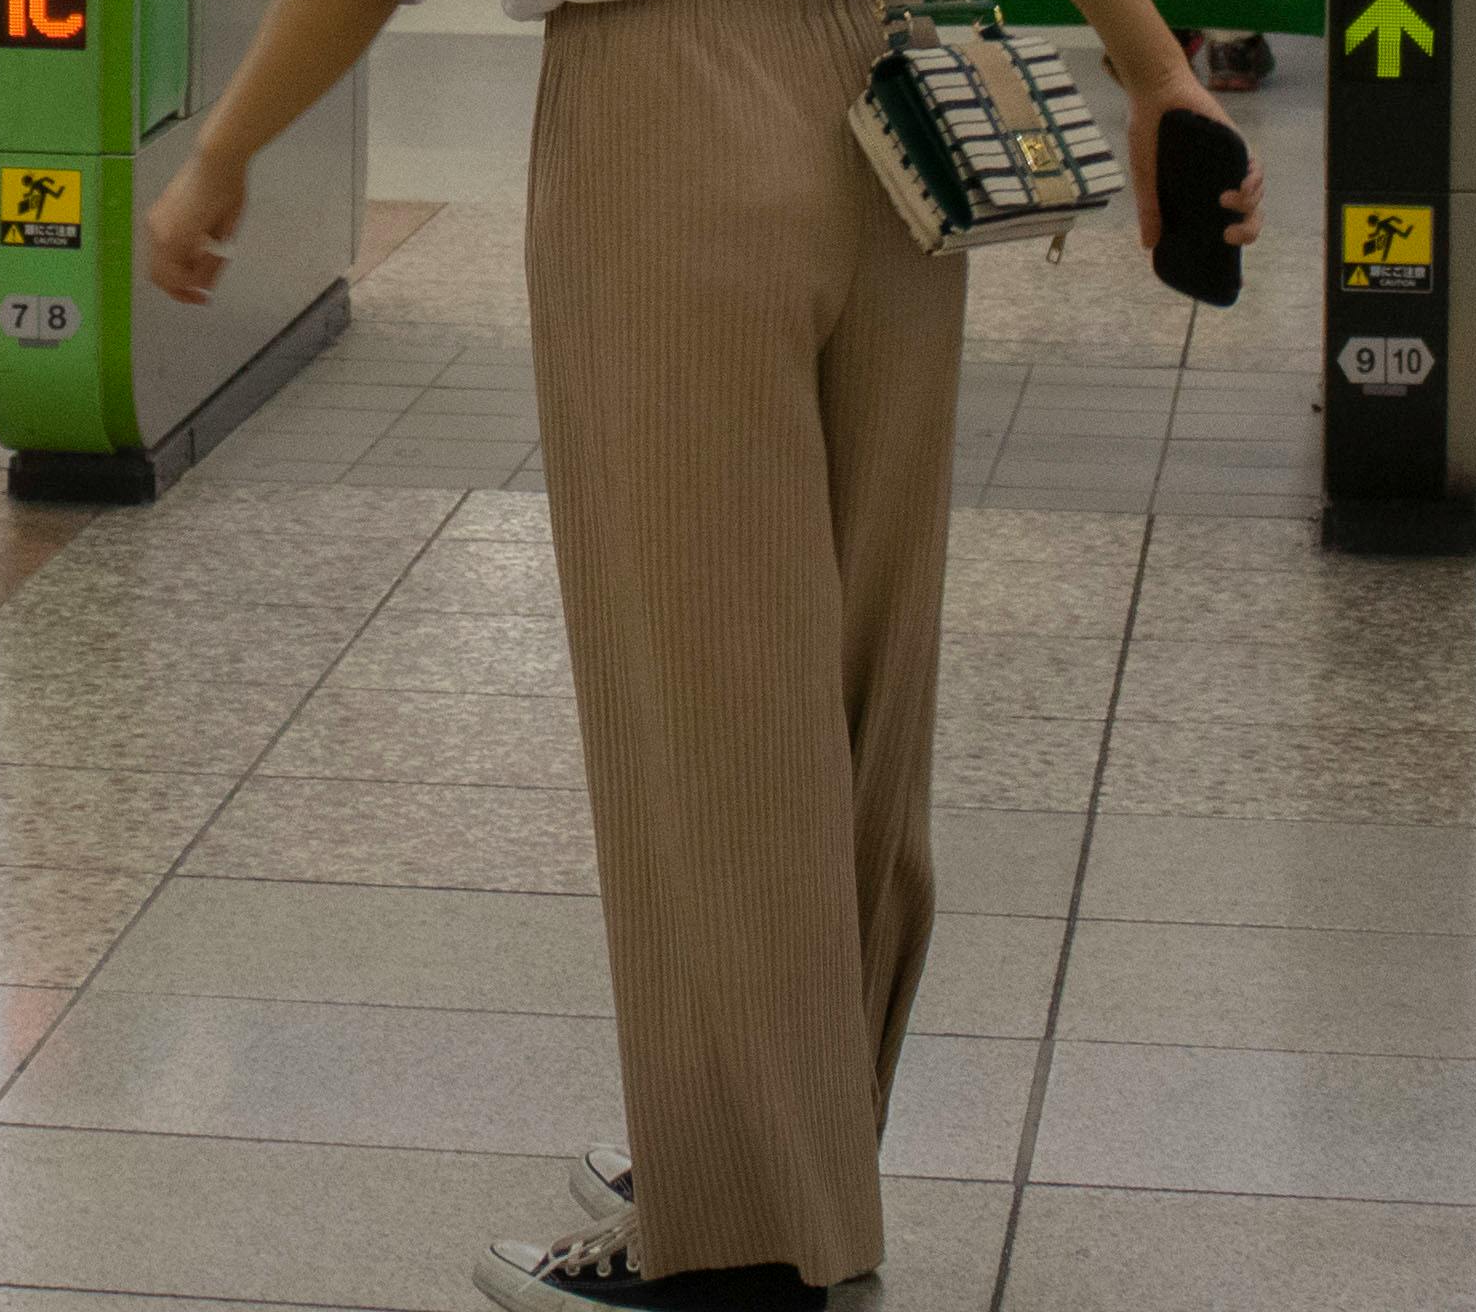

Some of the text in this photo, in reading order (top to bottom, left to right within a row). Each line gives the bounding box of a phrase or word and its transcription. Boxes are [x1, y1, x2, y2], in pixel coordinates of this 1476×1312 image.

[11, 303, 67, 330] 7 8
[1356, 347, 1422, 374] 9 10
